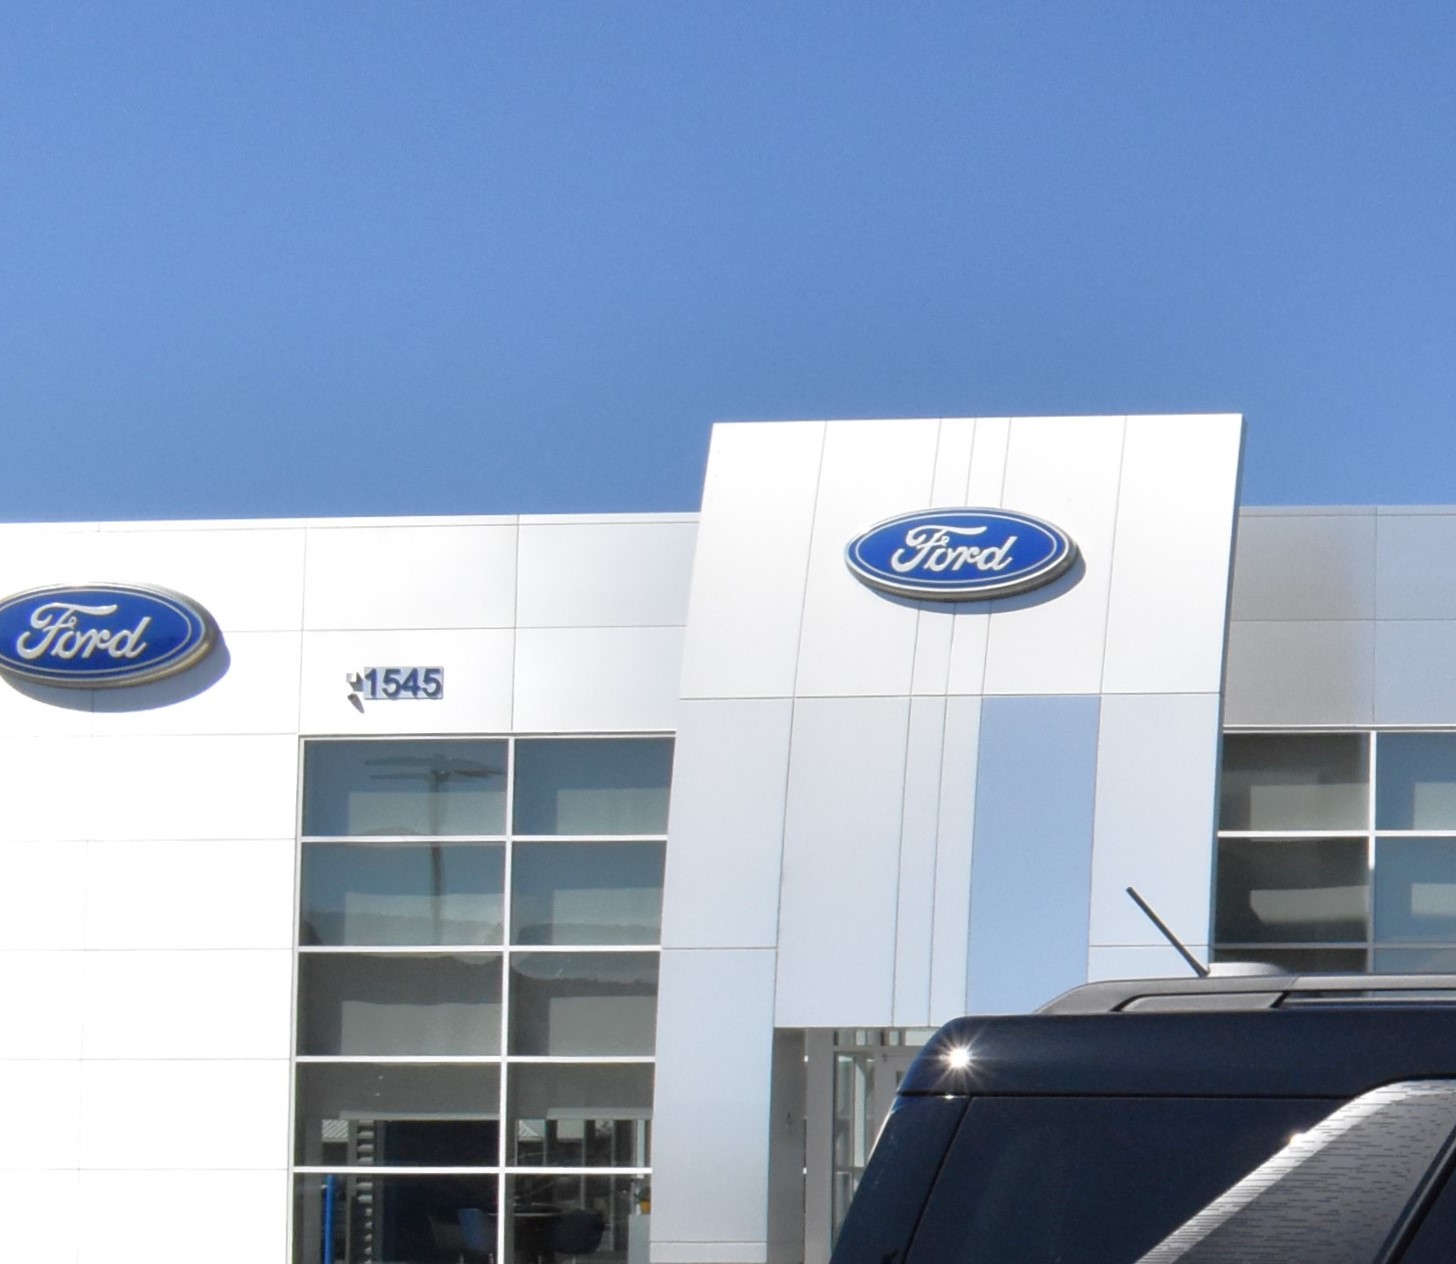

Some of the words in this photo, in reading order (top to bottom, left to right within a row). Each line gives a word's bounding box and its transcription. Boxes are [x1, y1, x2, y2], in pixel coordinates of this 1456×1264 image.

[890, 524, 1017, 573] Ford
[16, 602, 152, 660] Ford
[363, 668, 443, 699] 1545
